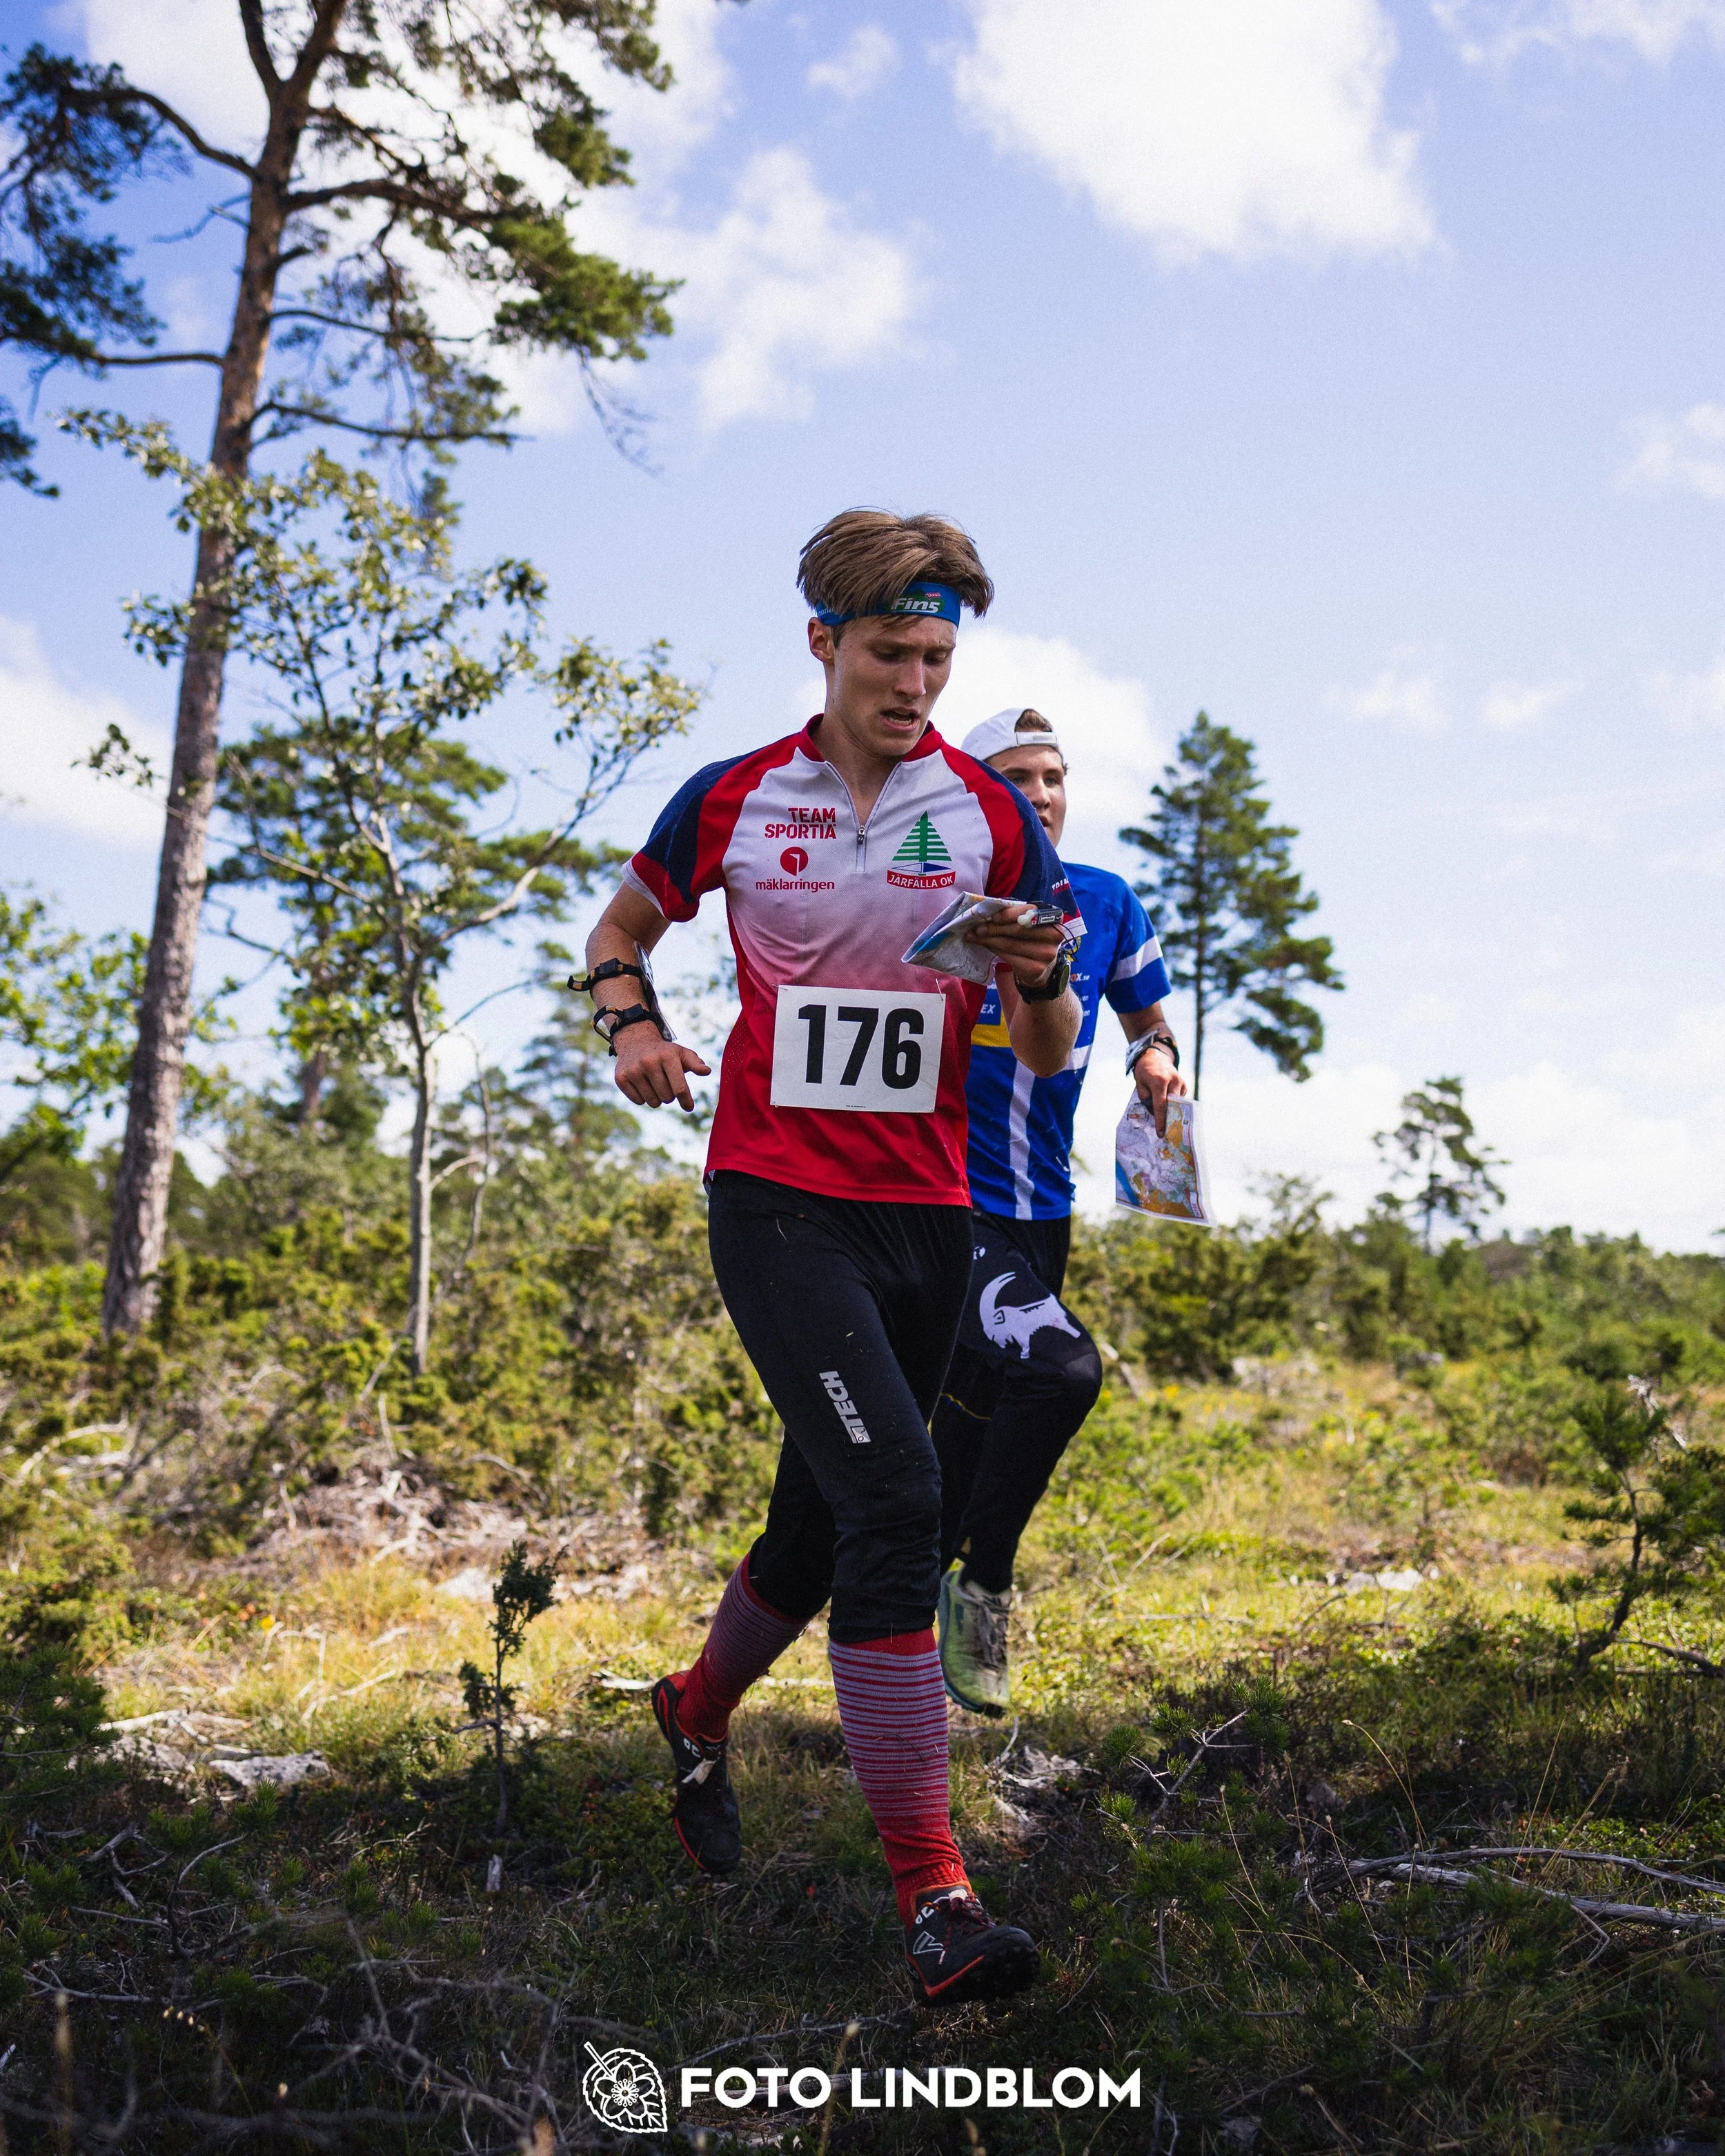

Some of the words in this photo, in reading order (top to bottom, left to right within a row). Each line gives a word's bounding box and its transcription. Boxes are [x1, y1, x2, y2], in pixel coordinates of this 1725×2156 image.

[788, 808, 836, 823] TEAM
[765, 824, 836, 839] SPORTIA
[756, 878, 835, 893] mäklarringen
[888, 874, 938, 888] JÄRFÄLLA
[940, 876, 953, 886] OK
[798, 1004, 925, 1089] 176
